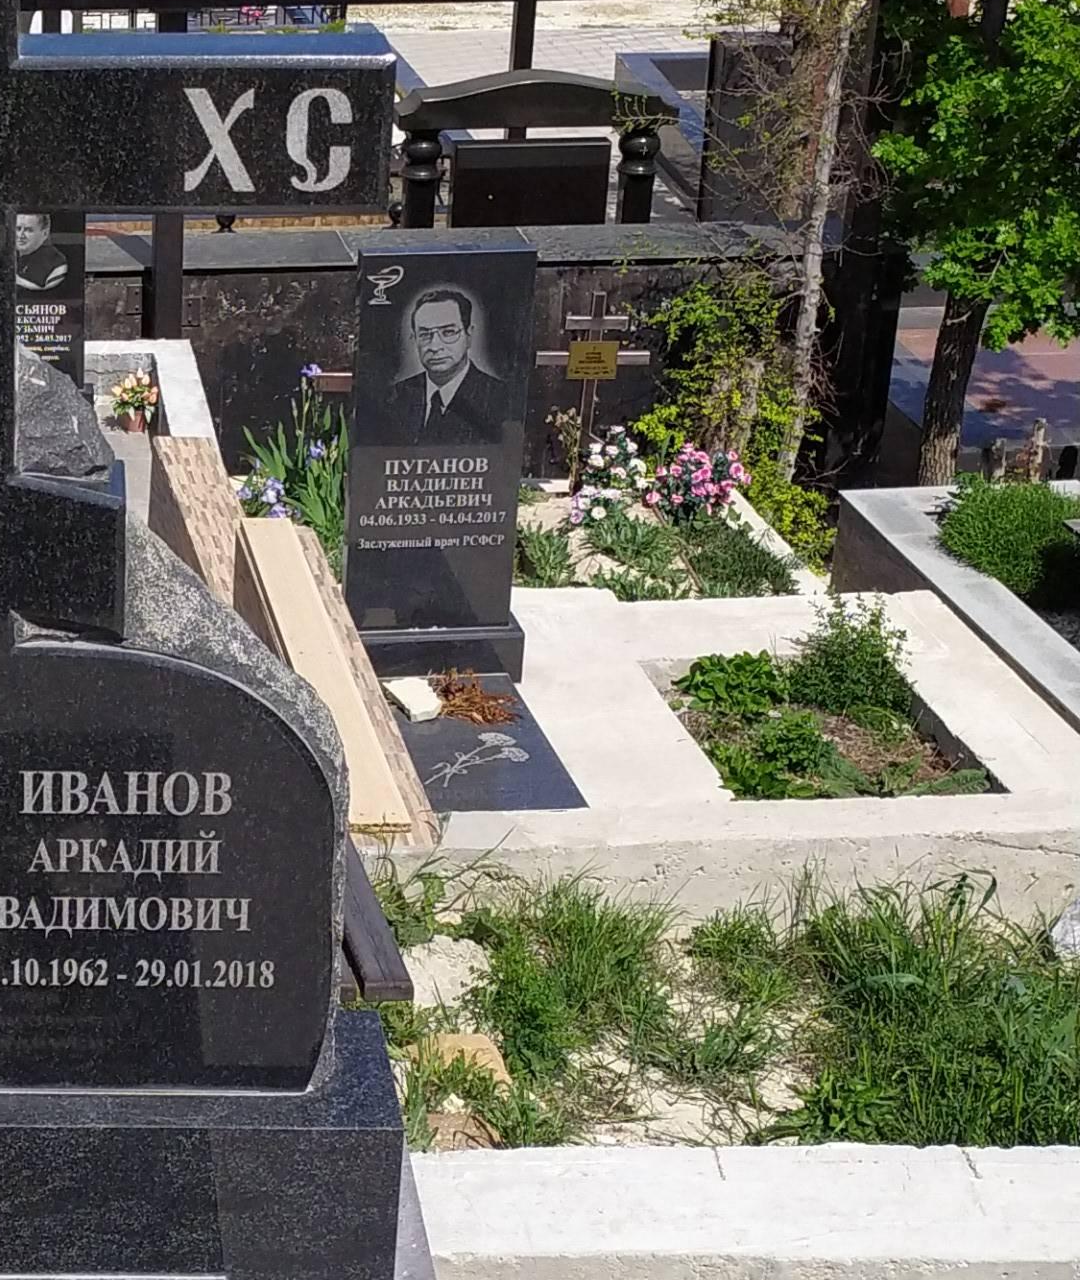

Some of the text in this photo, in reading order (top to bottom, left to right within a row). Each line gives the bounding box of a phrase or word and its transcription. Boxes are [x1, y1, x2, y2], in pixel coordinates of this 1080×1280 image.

[384, 458, 489, 475] ПУГАНОВ
[386, 477, 484, 492] ВЛАДИЛЕН
[375, 494, 492, 509] АРКАДЬЕВИЧ
[359, 513, 427, 526] 04.06.1933
[439, 512, 506, 524] 04.04.2017
[357, 535, 505, 551] Заслуженный врач РСФСР
[19, 770, 232, 816] ИВАНОВ
[27, 829, 222, 883] АРКАДИЙ
[135, 959, 275, 988] 29.01.2018
